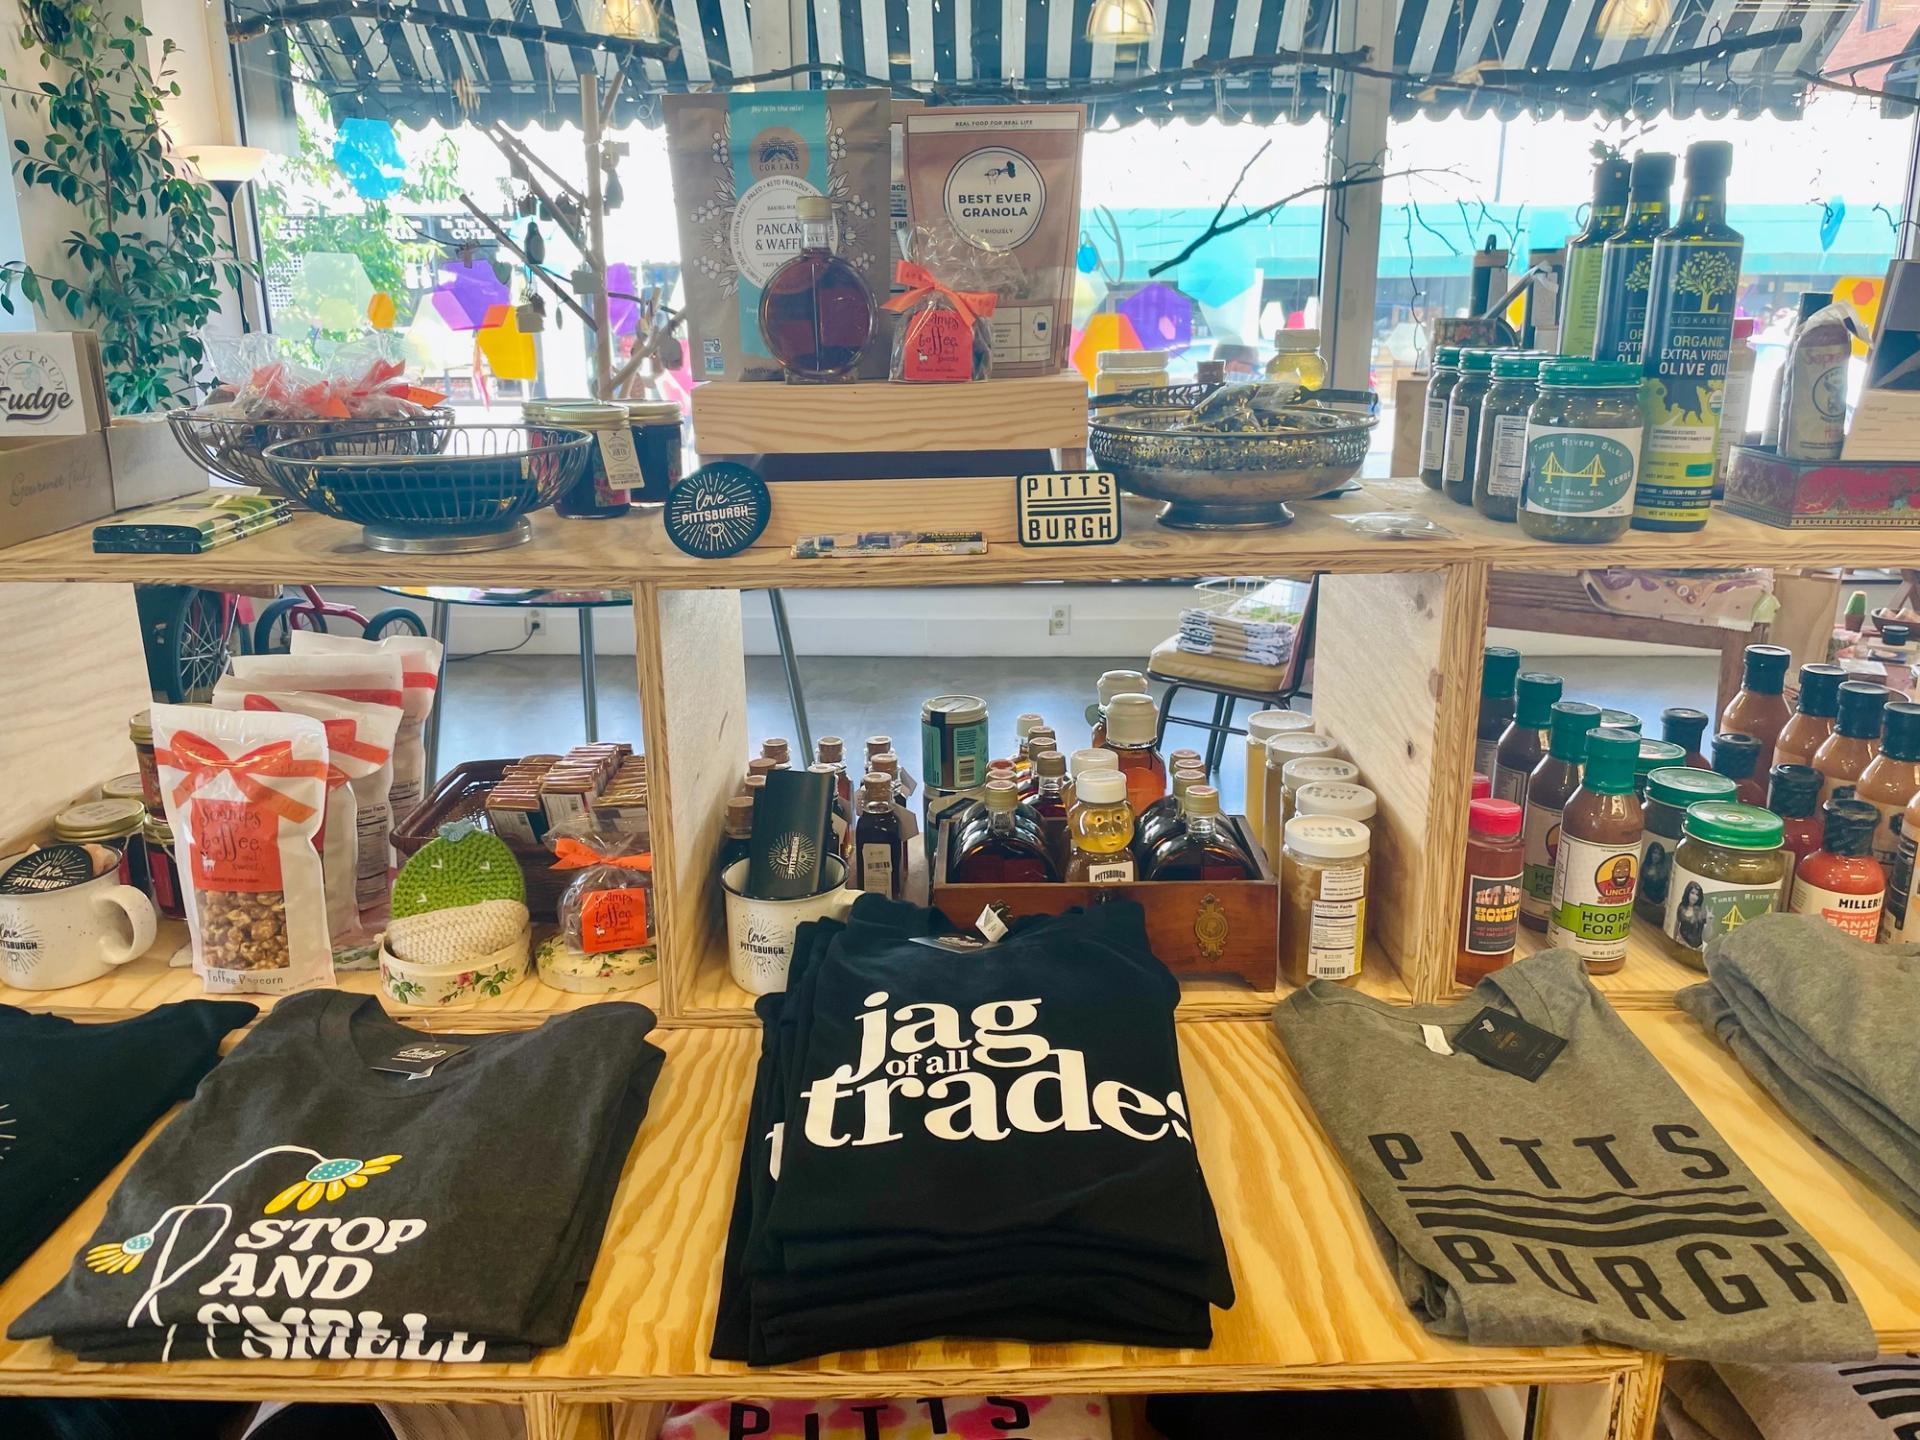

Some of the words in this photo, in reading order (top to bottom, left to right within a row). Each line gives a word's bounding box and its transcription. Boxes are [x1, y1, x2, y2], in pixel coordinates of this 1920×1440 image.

[958, 194, 992, 204] BEST
[996, 193, 1031, 204] EVER
[962, 207, 1028, 218] GRANOLA
[755, 240, 763, 251] &
[1673, 335, 1726, 348] ORGANIC
[1660, 349, 1698, 361] EXTRA
[1659, 362, 1706, 376] OLIVE
[1710, 363, 1728, 376] OIL
[0, 386, 74, 421] Fudge
[1561, 437, 1595, 447] RIVERS
[1027, 476, 1110, 498] PITTS
[696, 488, 730, 512] love
[681, 505, 750, 525] PITTSBURGH
[1028, 516, 1112, 541] BURGH
[12, 877, 72, 890] PITTSBUR
[748, 927, 769, 943] love
[1583, 924, 1614, 935] FOR
[740, 941, 786, 956] PITTSBURGH
[854, 991, 1051, 1085] jag
[885, 1053, 923, 1076] of
[926, 1049, 970, 1075] all
[1367, 1124, 1730, 1190] PITTS
[235, 1217, 428, 1255] STOP
[198, 1254, 375, 1300] AND
[1434, 1234, 1849, 1322] BURGH
